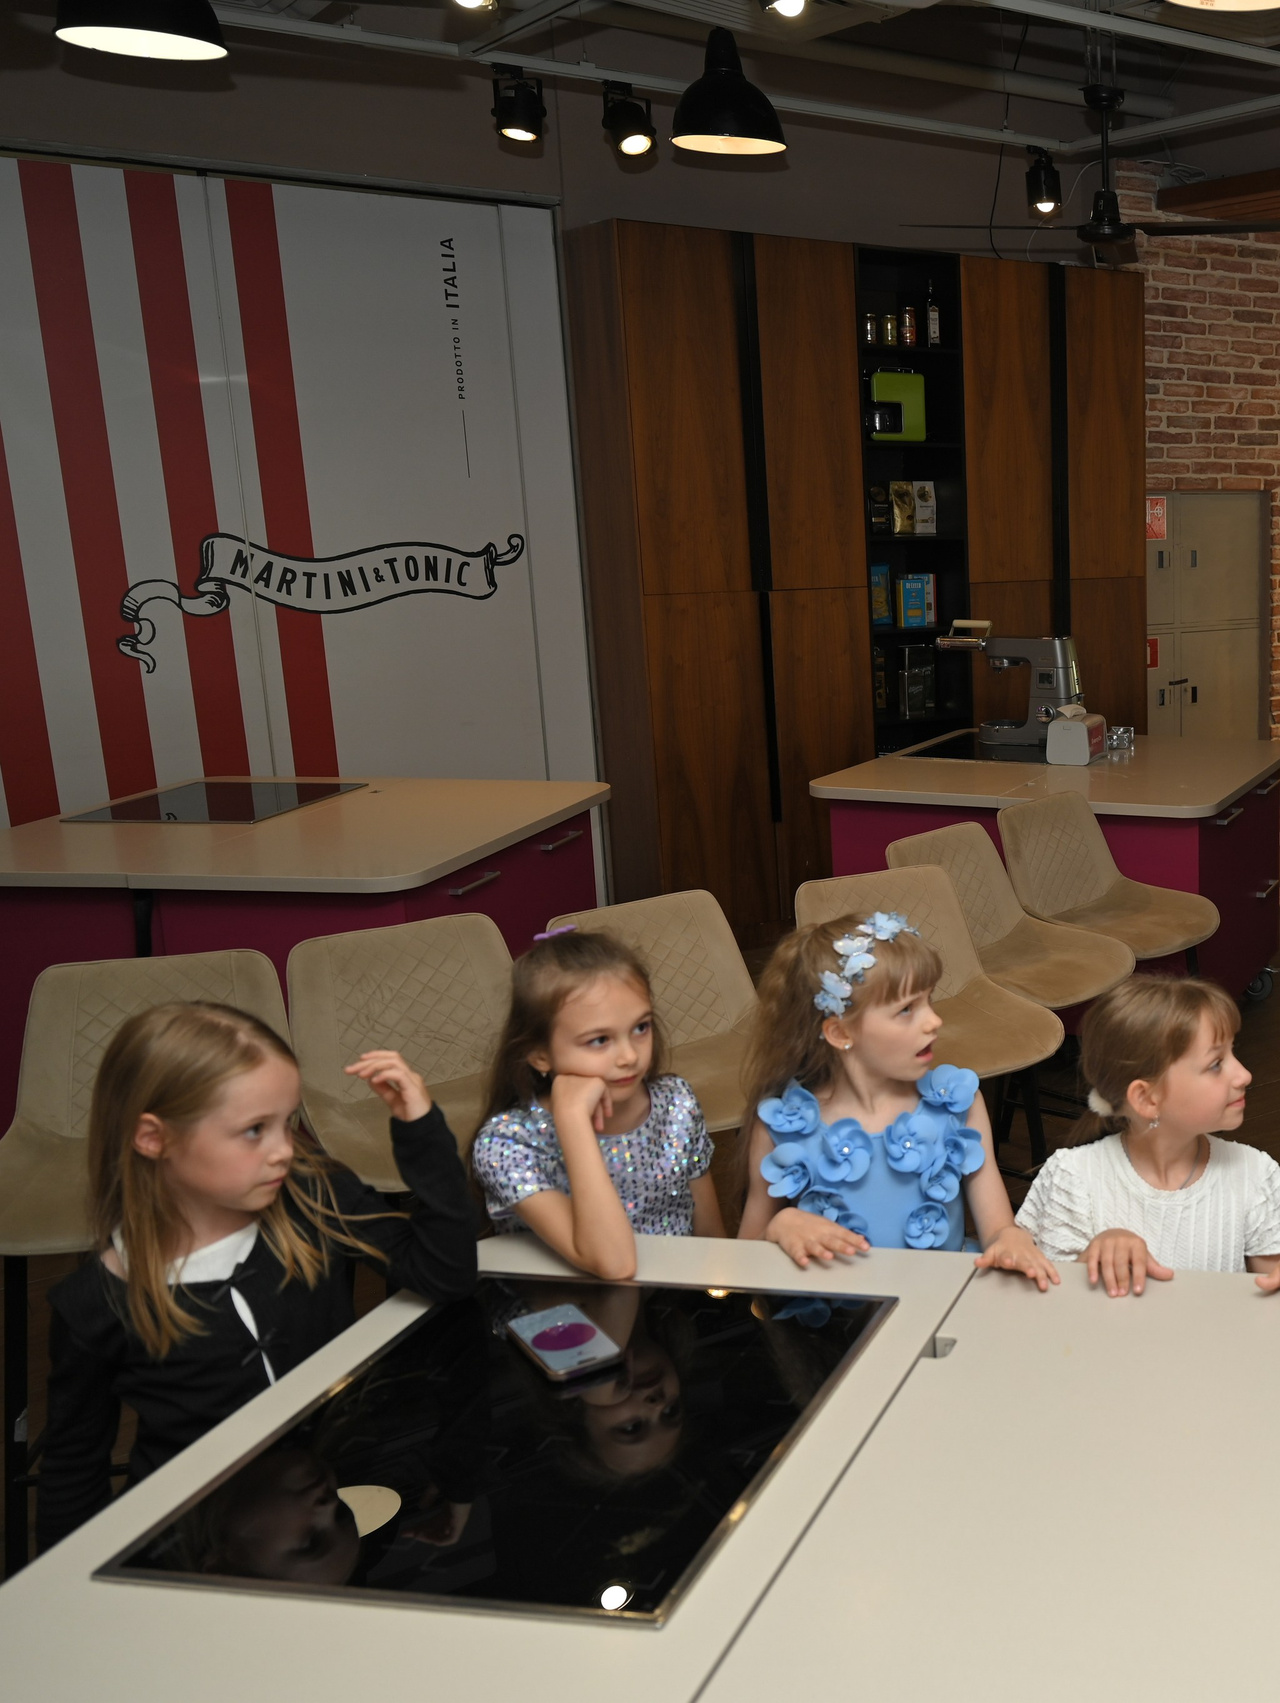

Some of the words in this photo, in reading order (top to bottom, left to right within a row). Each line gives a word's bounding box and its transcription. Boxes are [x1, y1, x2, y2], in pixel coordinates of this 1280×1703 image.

[440, 237, 461, 309] ITALIA
[451, 318, 460, 331] IN
[453, 336, 466, 400] PRODOTTO
